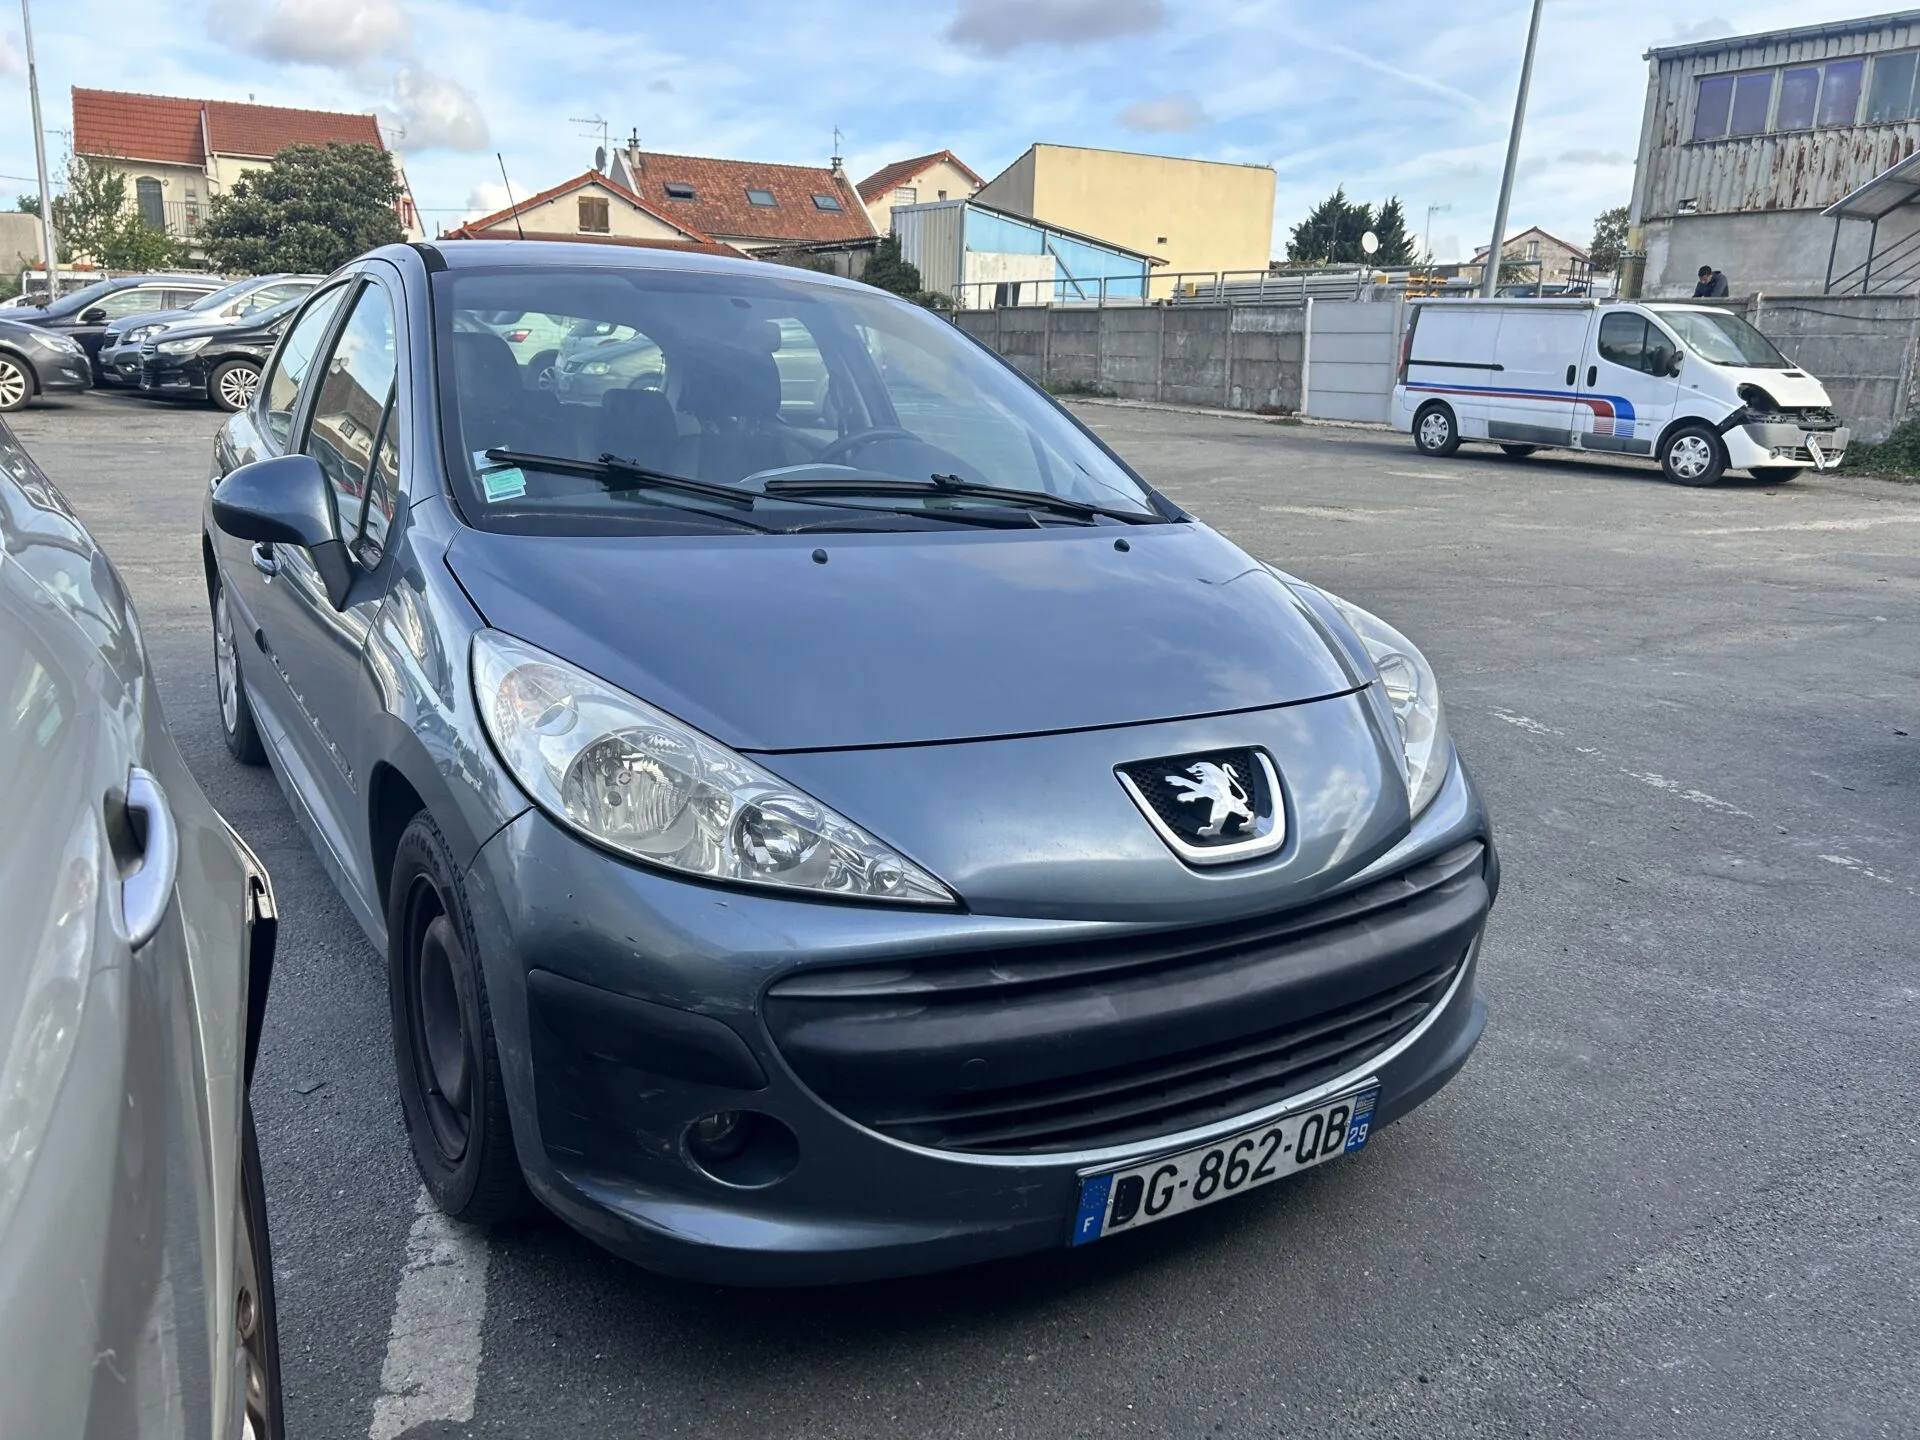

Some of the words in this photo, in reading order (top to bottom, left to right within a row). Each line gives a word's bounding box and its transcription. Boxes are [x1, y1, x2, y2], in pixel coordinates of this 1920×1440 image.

[1347, 1123, 1369, 1147] 29
[1108, 1105, 1350, 1228] DG-862-QB
[1083, 1217, 1094, 1233] F
